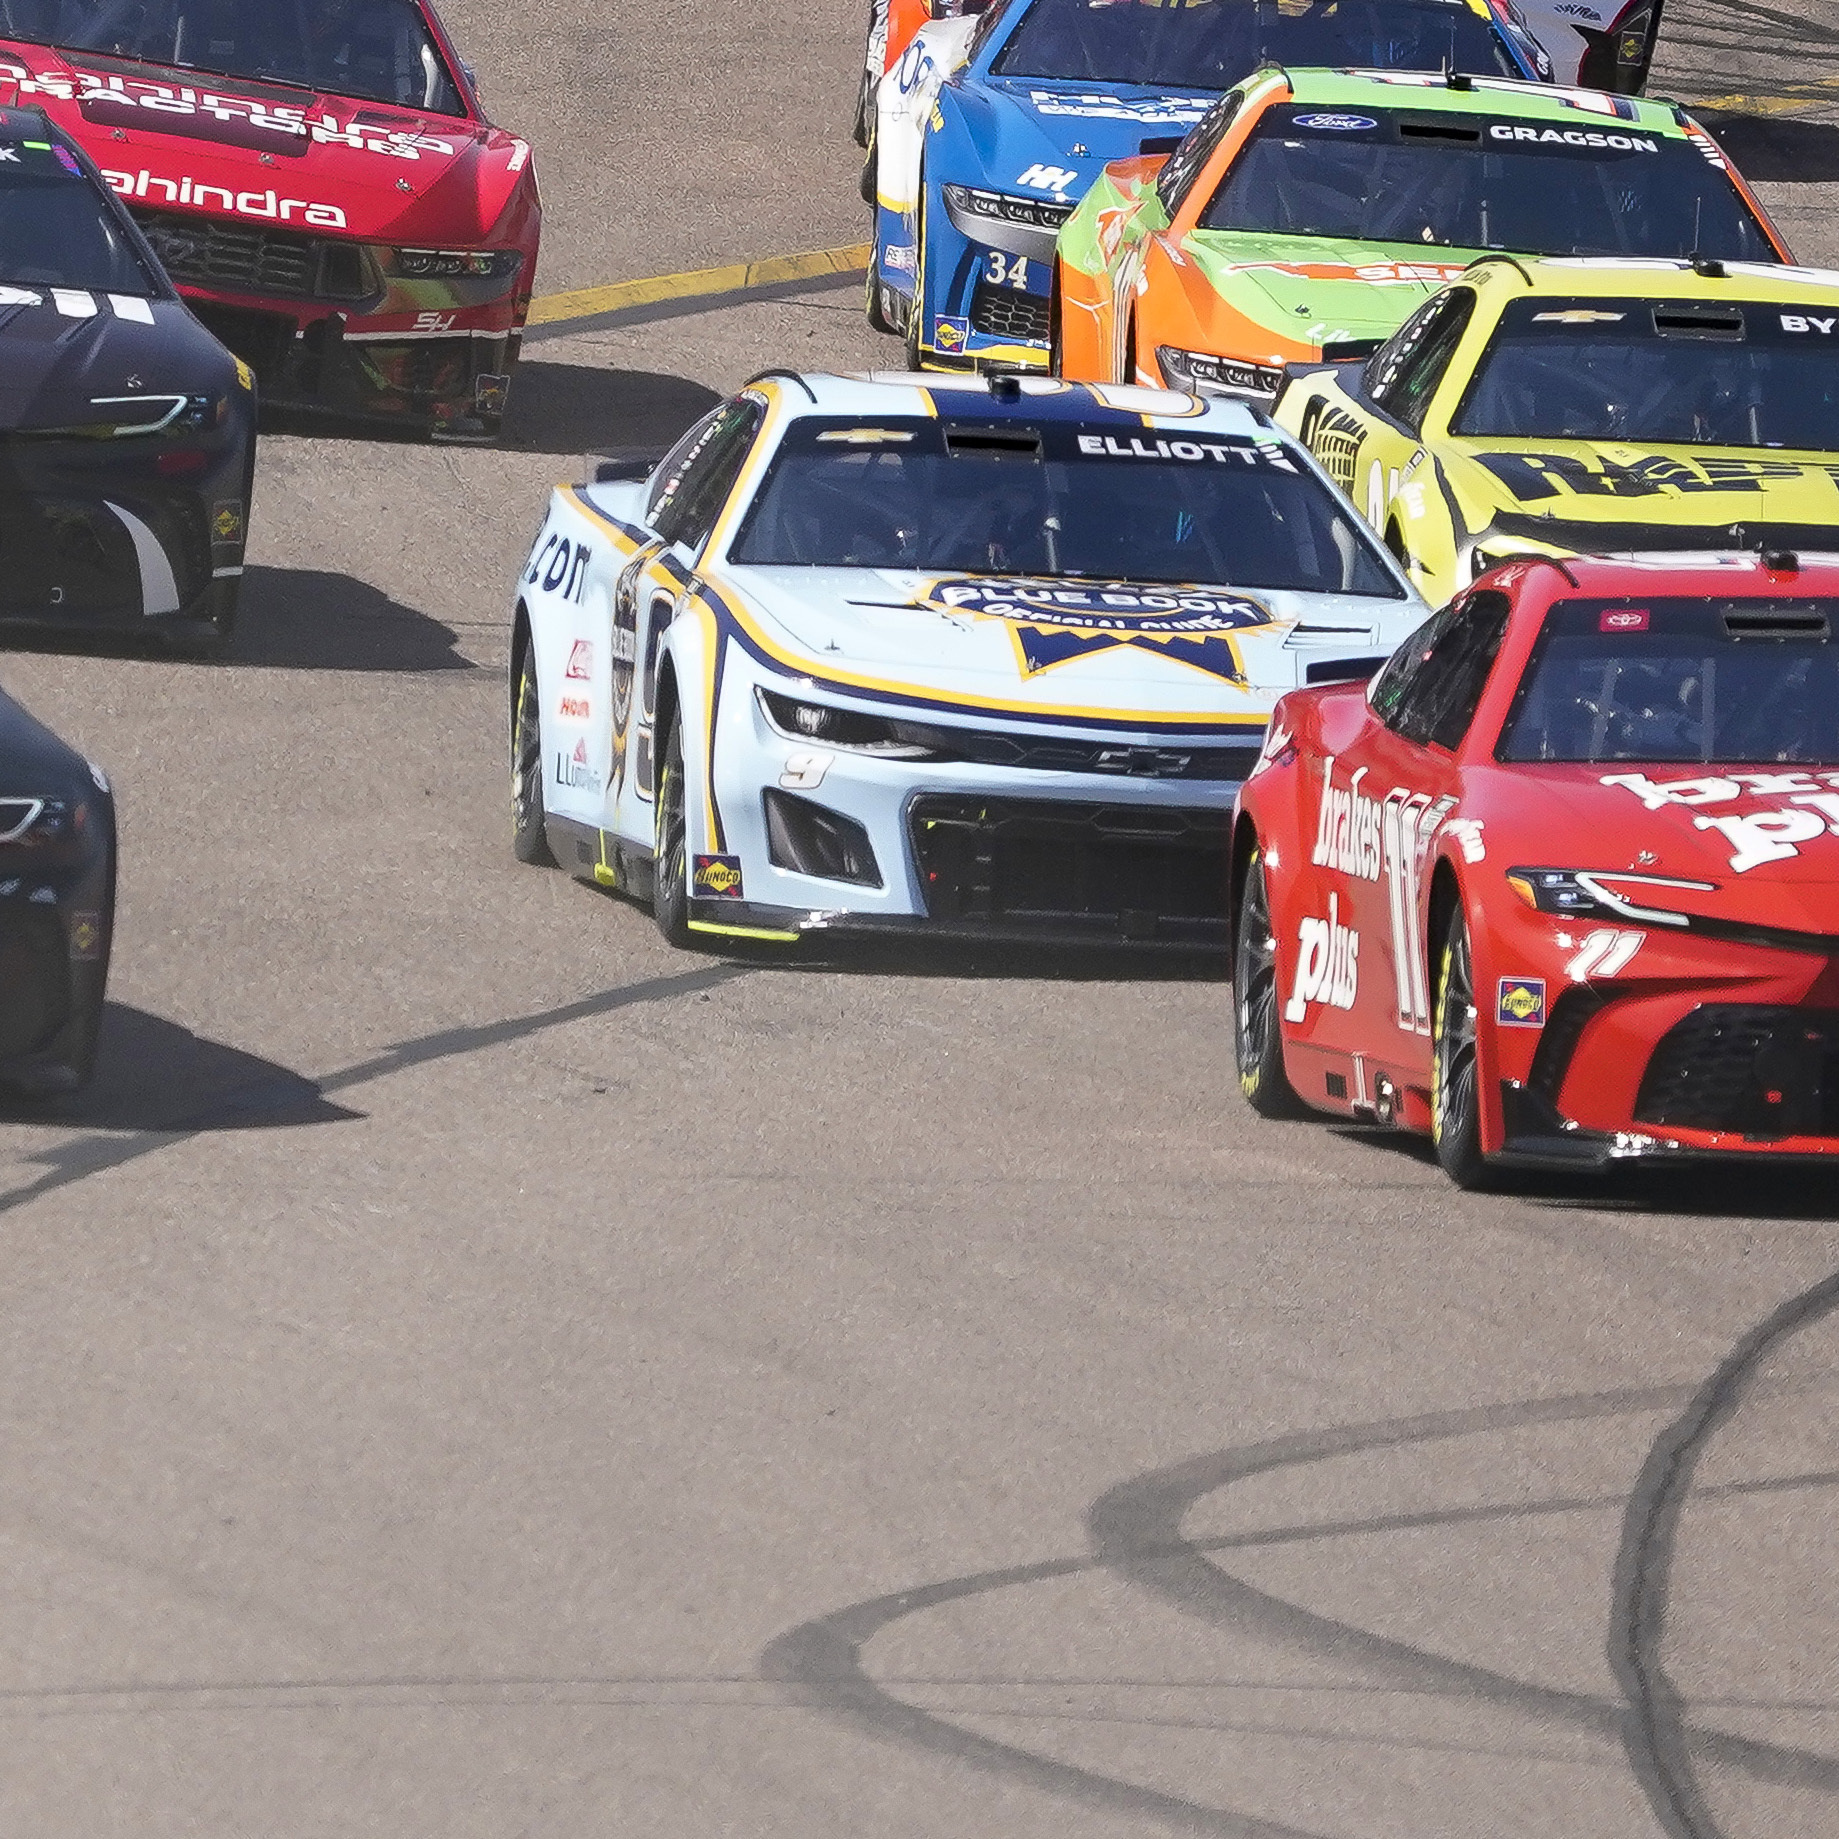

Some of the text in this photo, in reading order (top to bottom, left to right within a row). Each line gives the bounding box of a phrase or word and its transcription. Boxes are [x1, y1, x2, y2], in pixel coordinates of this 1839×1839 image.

[1292, 114, 1377, 130] Ford
[1490, 125, 1658, 154] GRAGSON
[97, 170, 346, 228] ahindra
[985, 252, 1027, 290] 34
[1077, 435, 1260, 467] ELLIOTT
[941, 585, 1099, 607] BLUE
[781, 752, 834, 789] 9
[1313, 756, 1382, 882] brakes
[1285, 892, 1359, 1023] plus
